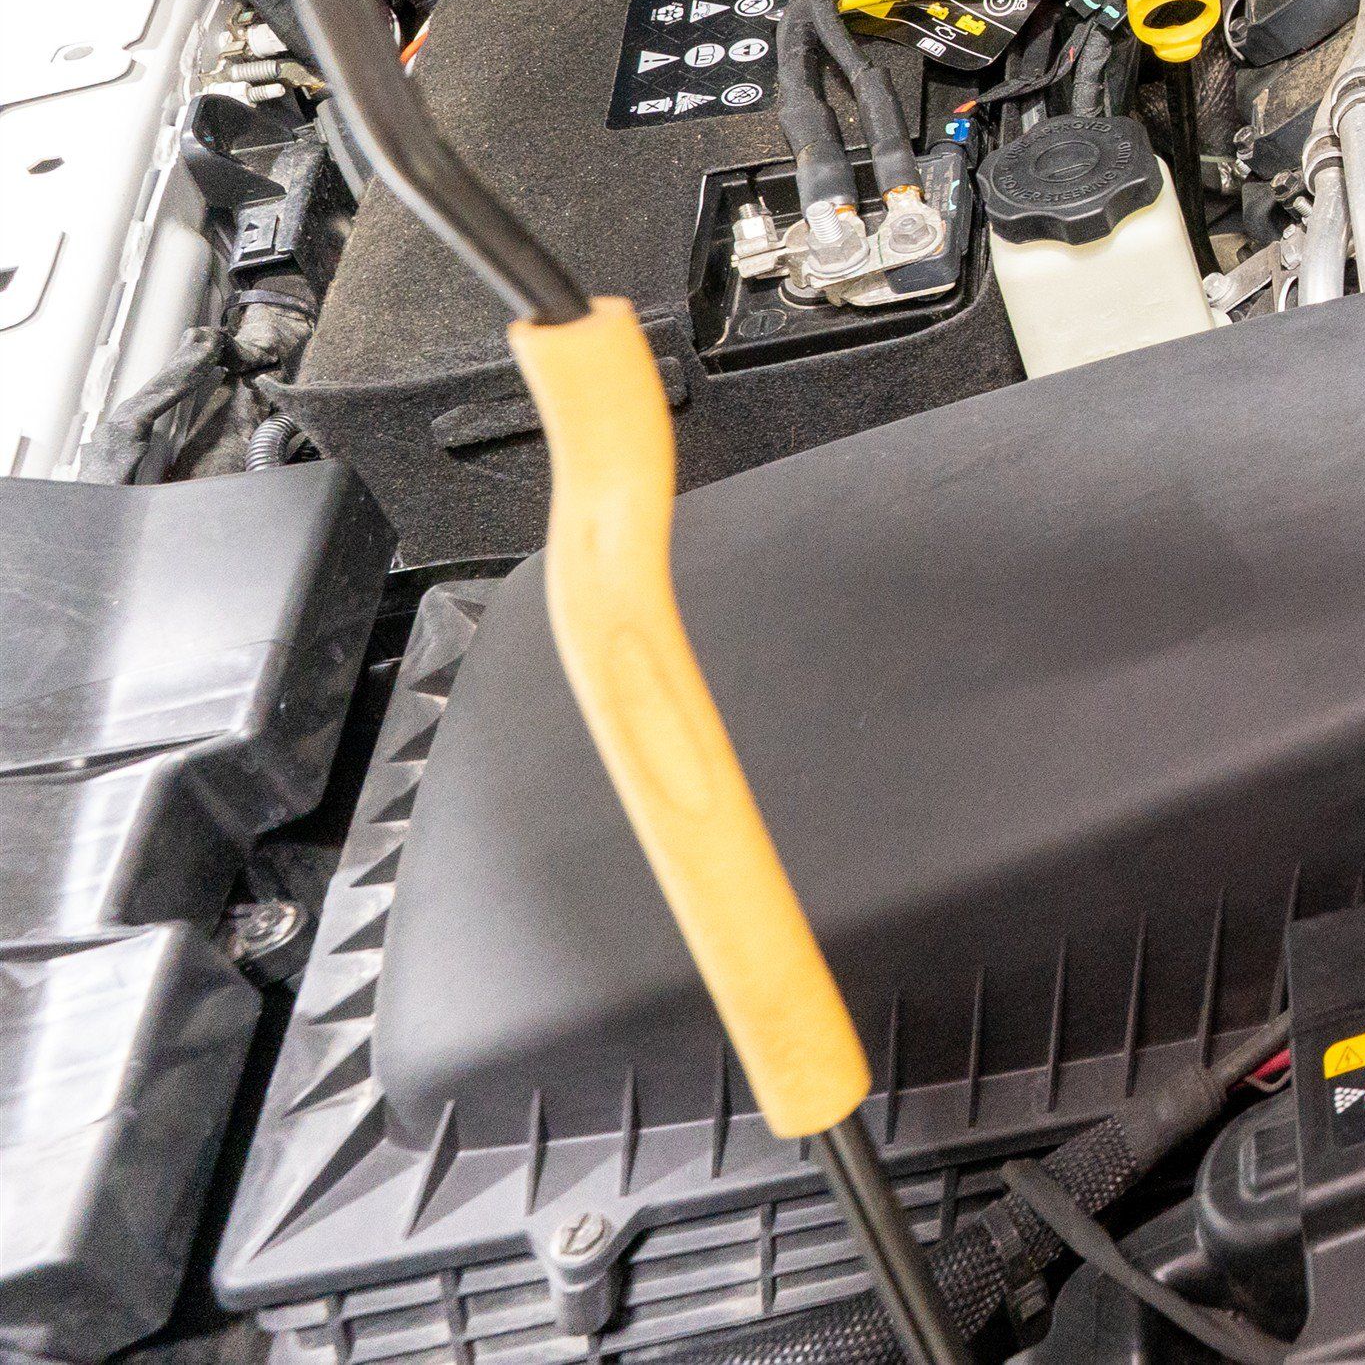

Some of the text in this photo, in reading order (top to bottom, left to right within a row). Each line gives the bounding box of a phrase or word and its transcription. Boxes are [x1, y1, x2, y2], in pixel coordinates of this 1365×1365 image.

[1005, 120, 1113, 161] USE APPROVED
[999, 140, 1132, 202] POWER STEERING FLUID
